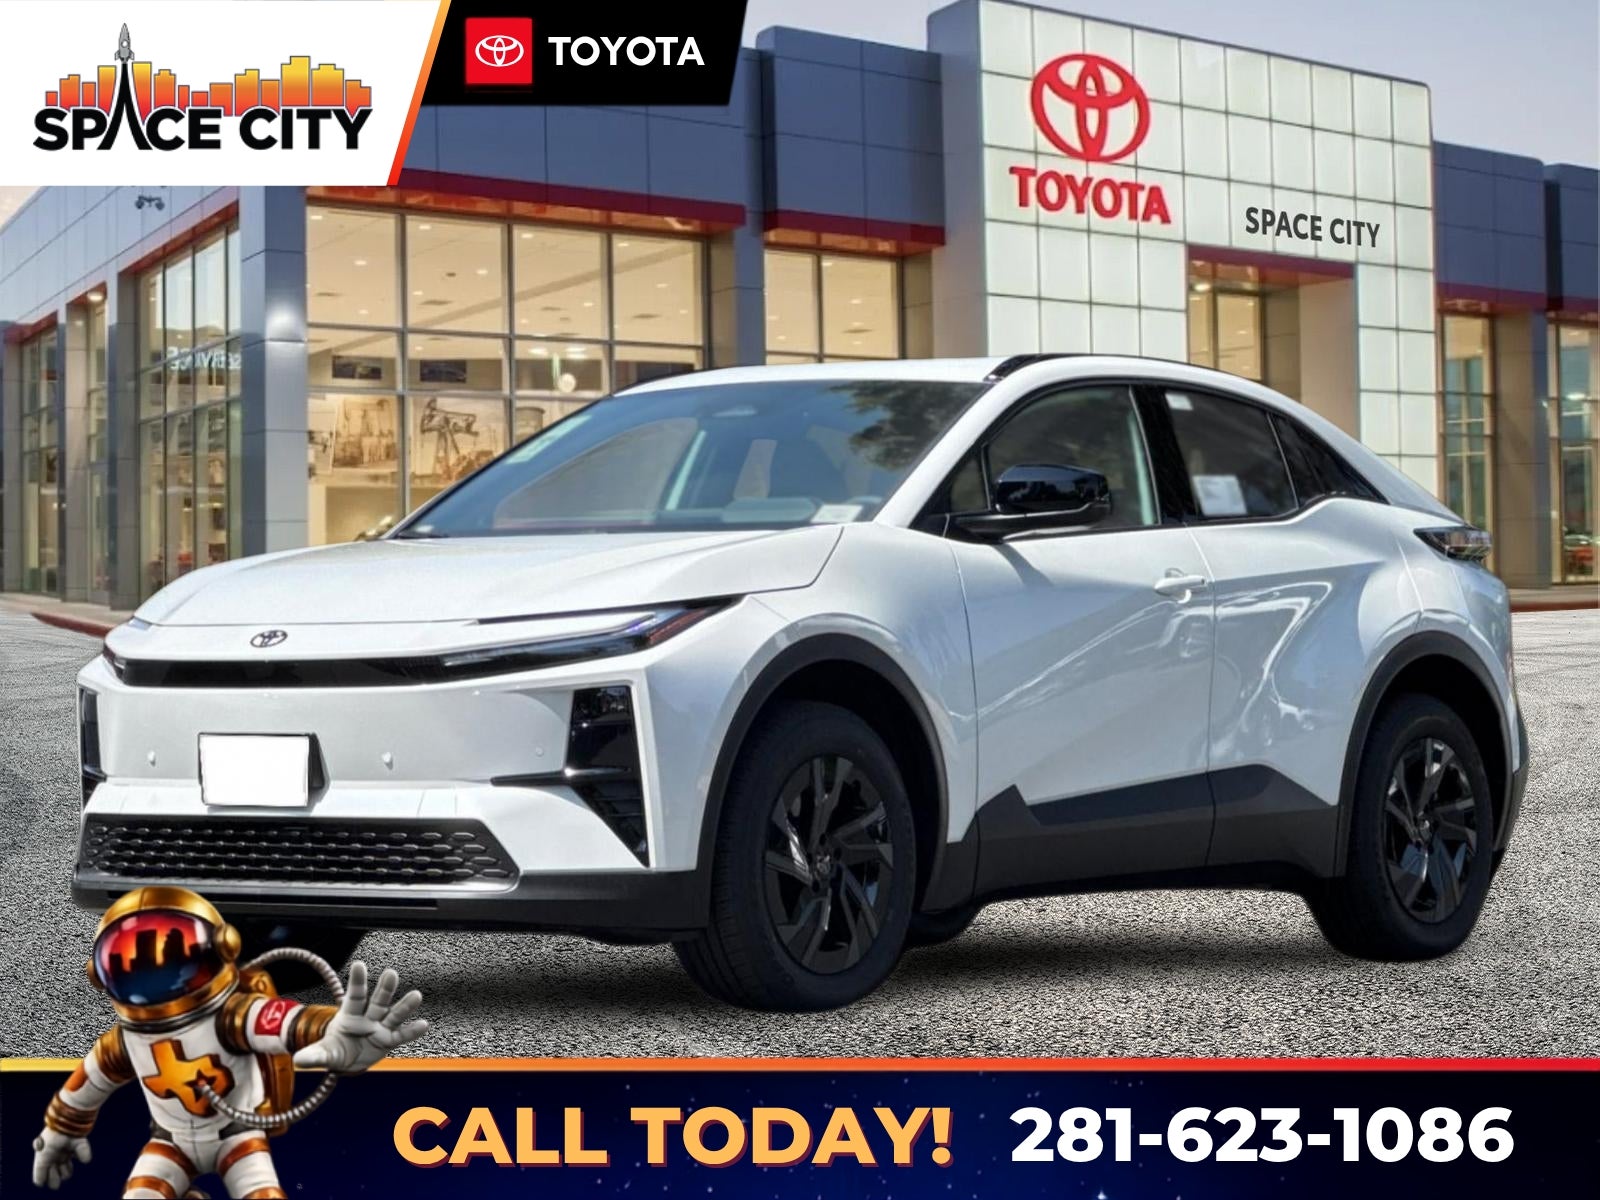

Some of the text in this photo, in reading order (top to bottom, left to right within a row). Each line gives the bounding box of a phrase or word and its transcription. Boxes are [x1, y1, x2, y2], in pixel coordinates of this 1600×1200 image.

[1009, 166, 1171, 224] TOYOTA
[1245, 206, 1380, 248] SPACE CITY
